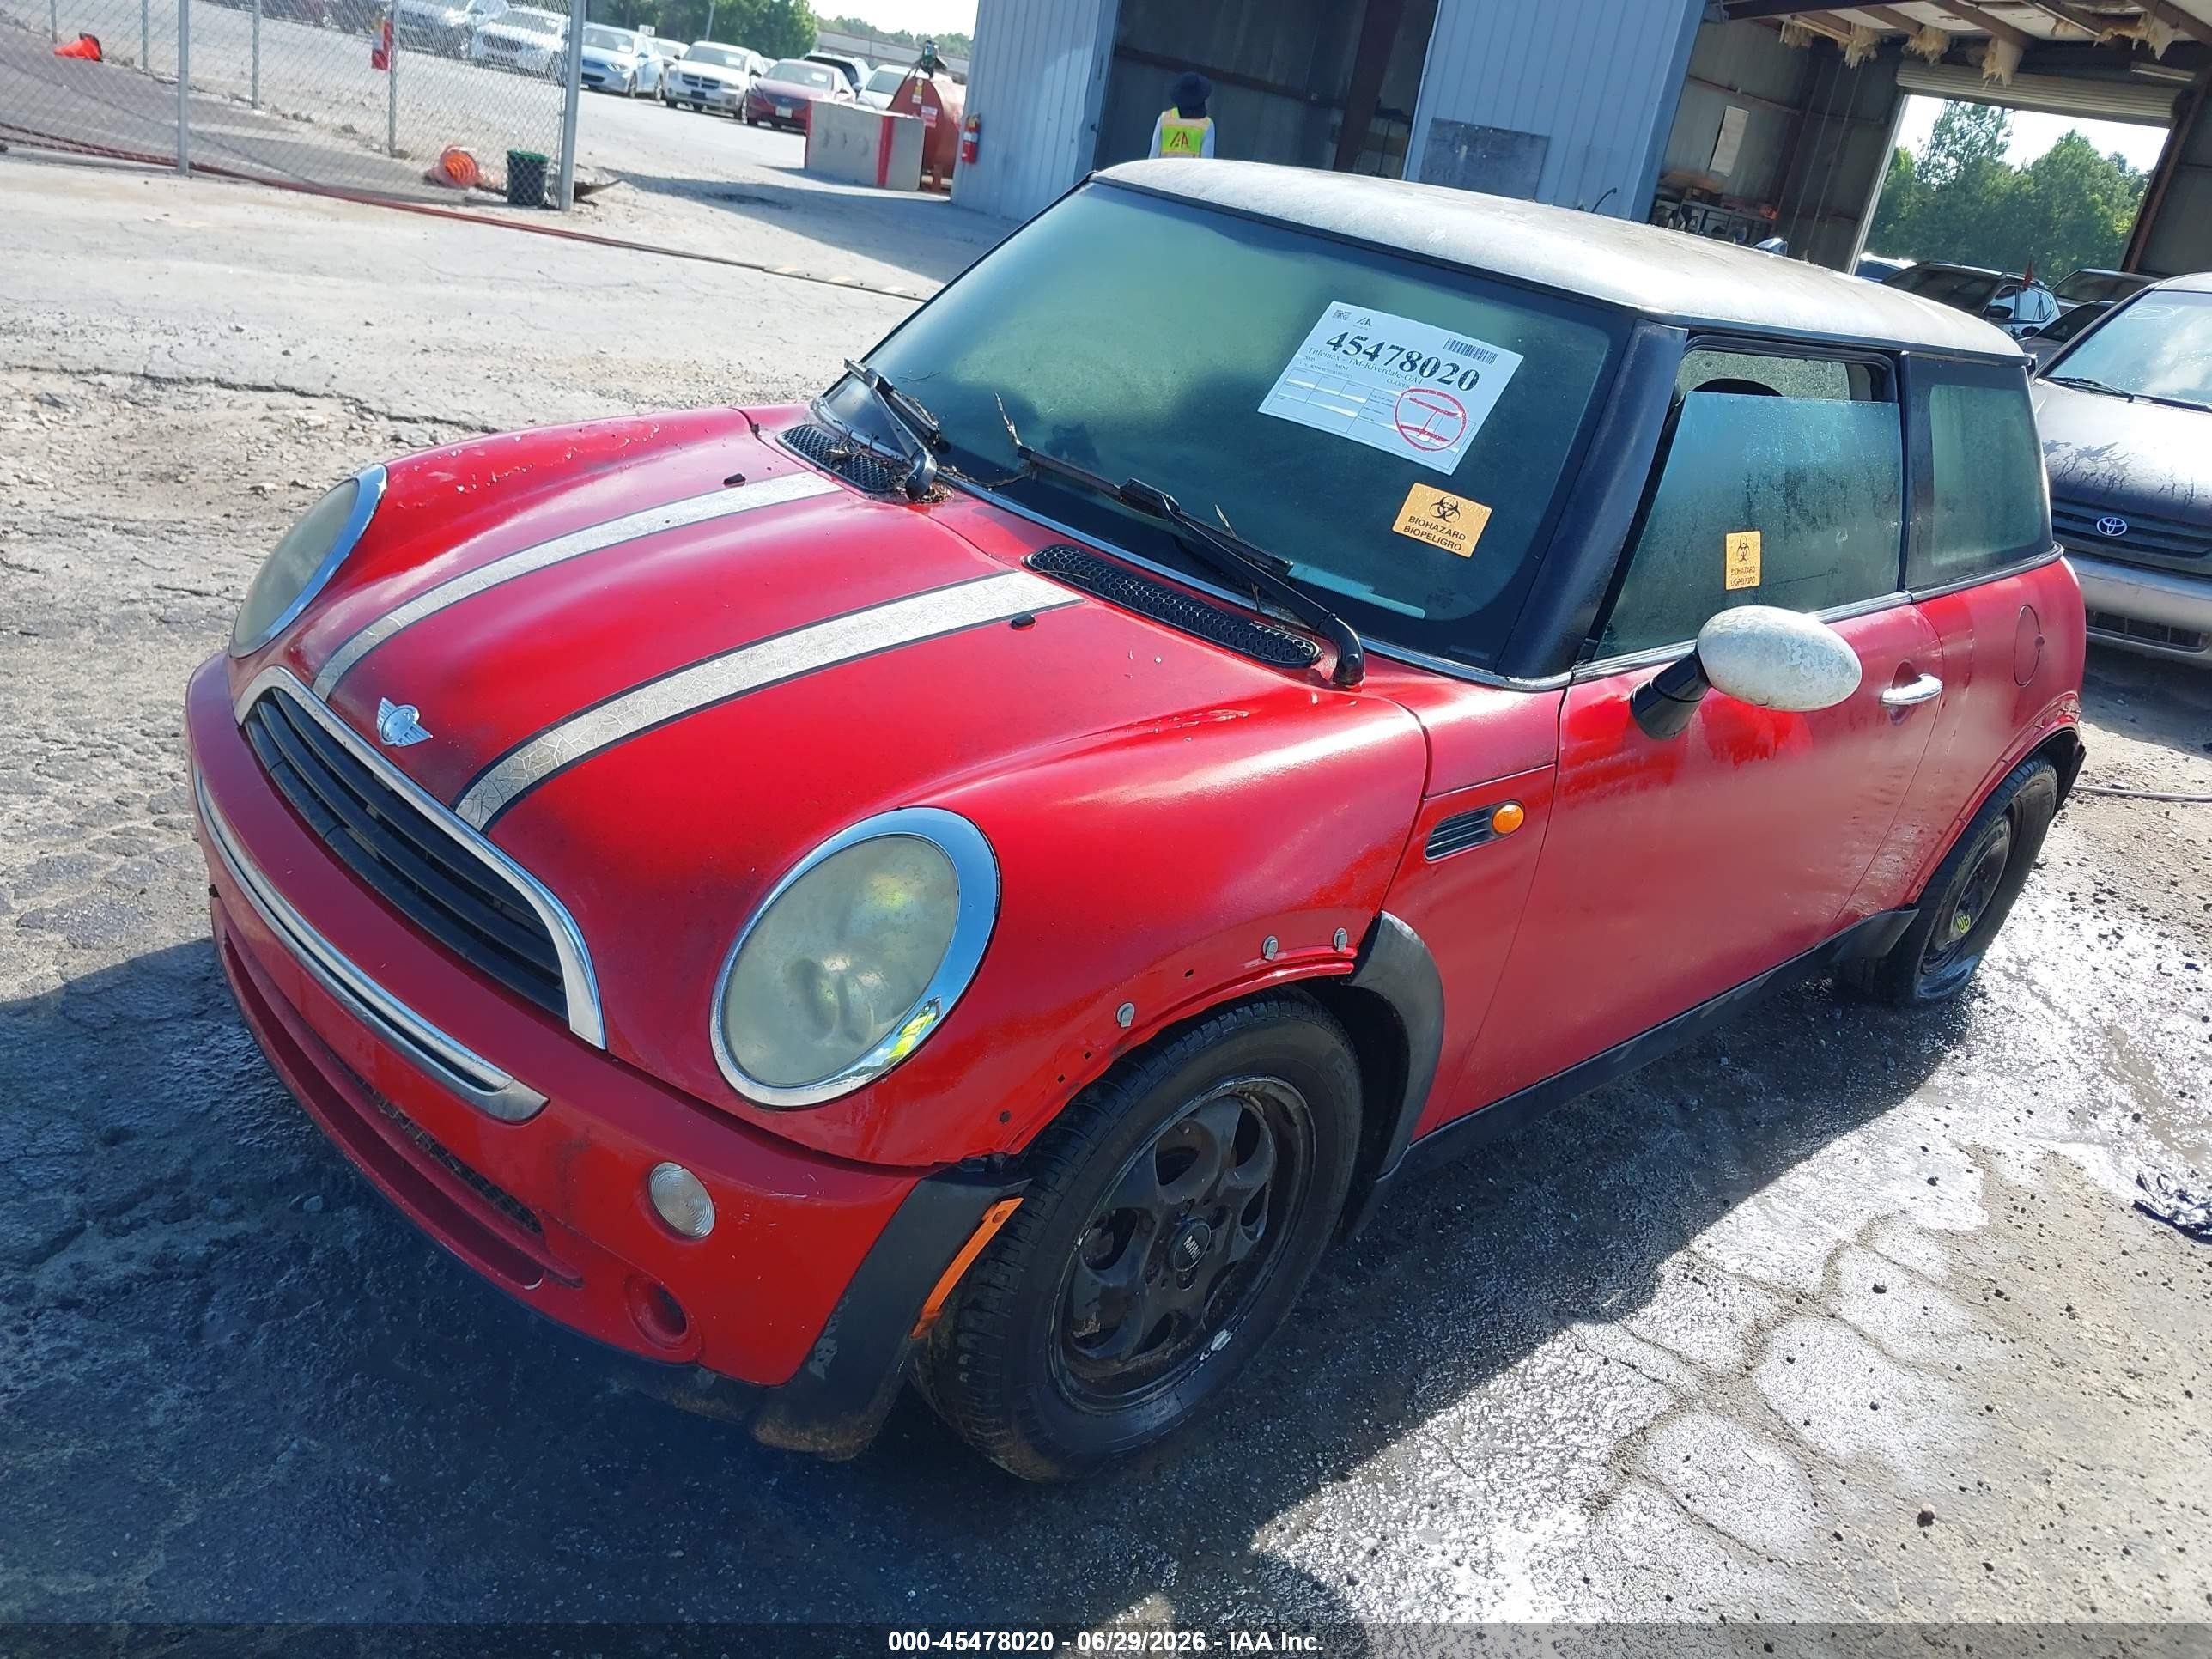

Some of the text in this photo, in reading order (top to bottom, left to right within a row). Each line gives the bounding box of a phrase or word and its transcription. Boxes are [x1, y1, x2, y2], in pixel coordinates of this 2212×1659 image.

[1308, 348, 1340, 362] Titlemax
[1325, 331, 1480, 391] 45478020
[1403, 526, 1462, 551] BIOPELIGRO
[1407, 515, 1466, 541] BIOHAZARD
[1183, 1235, 1201, 1260] MINI
